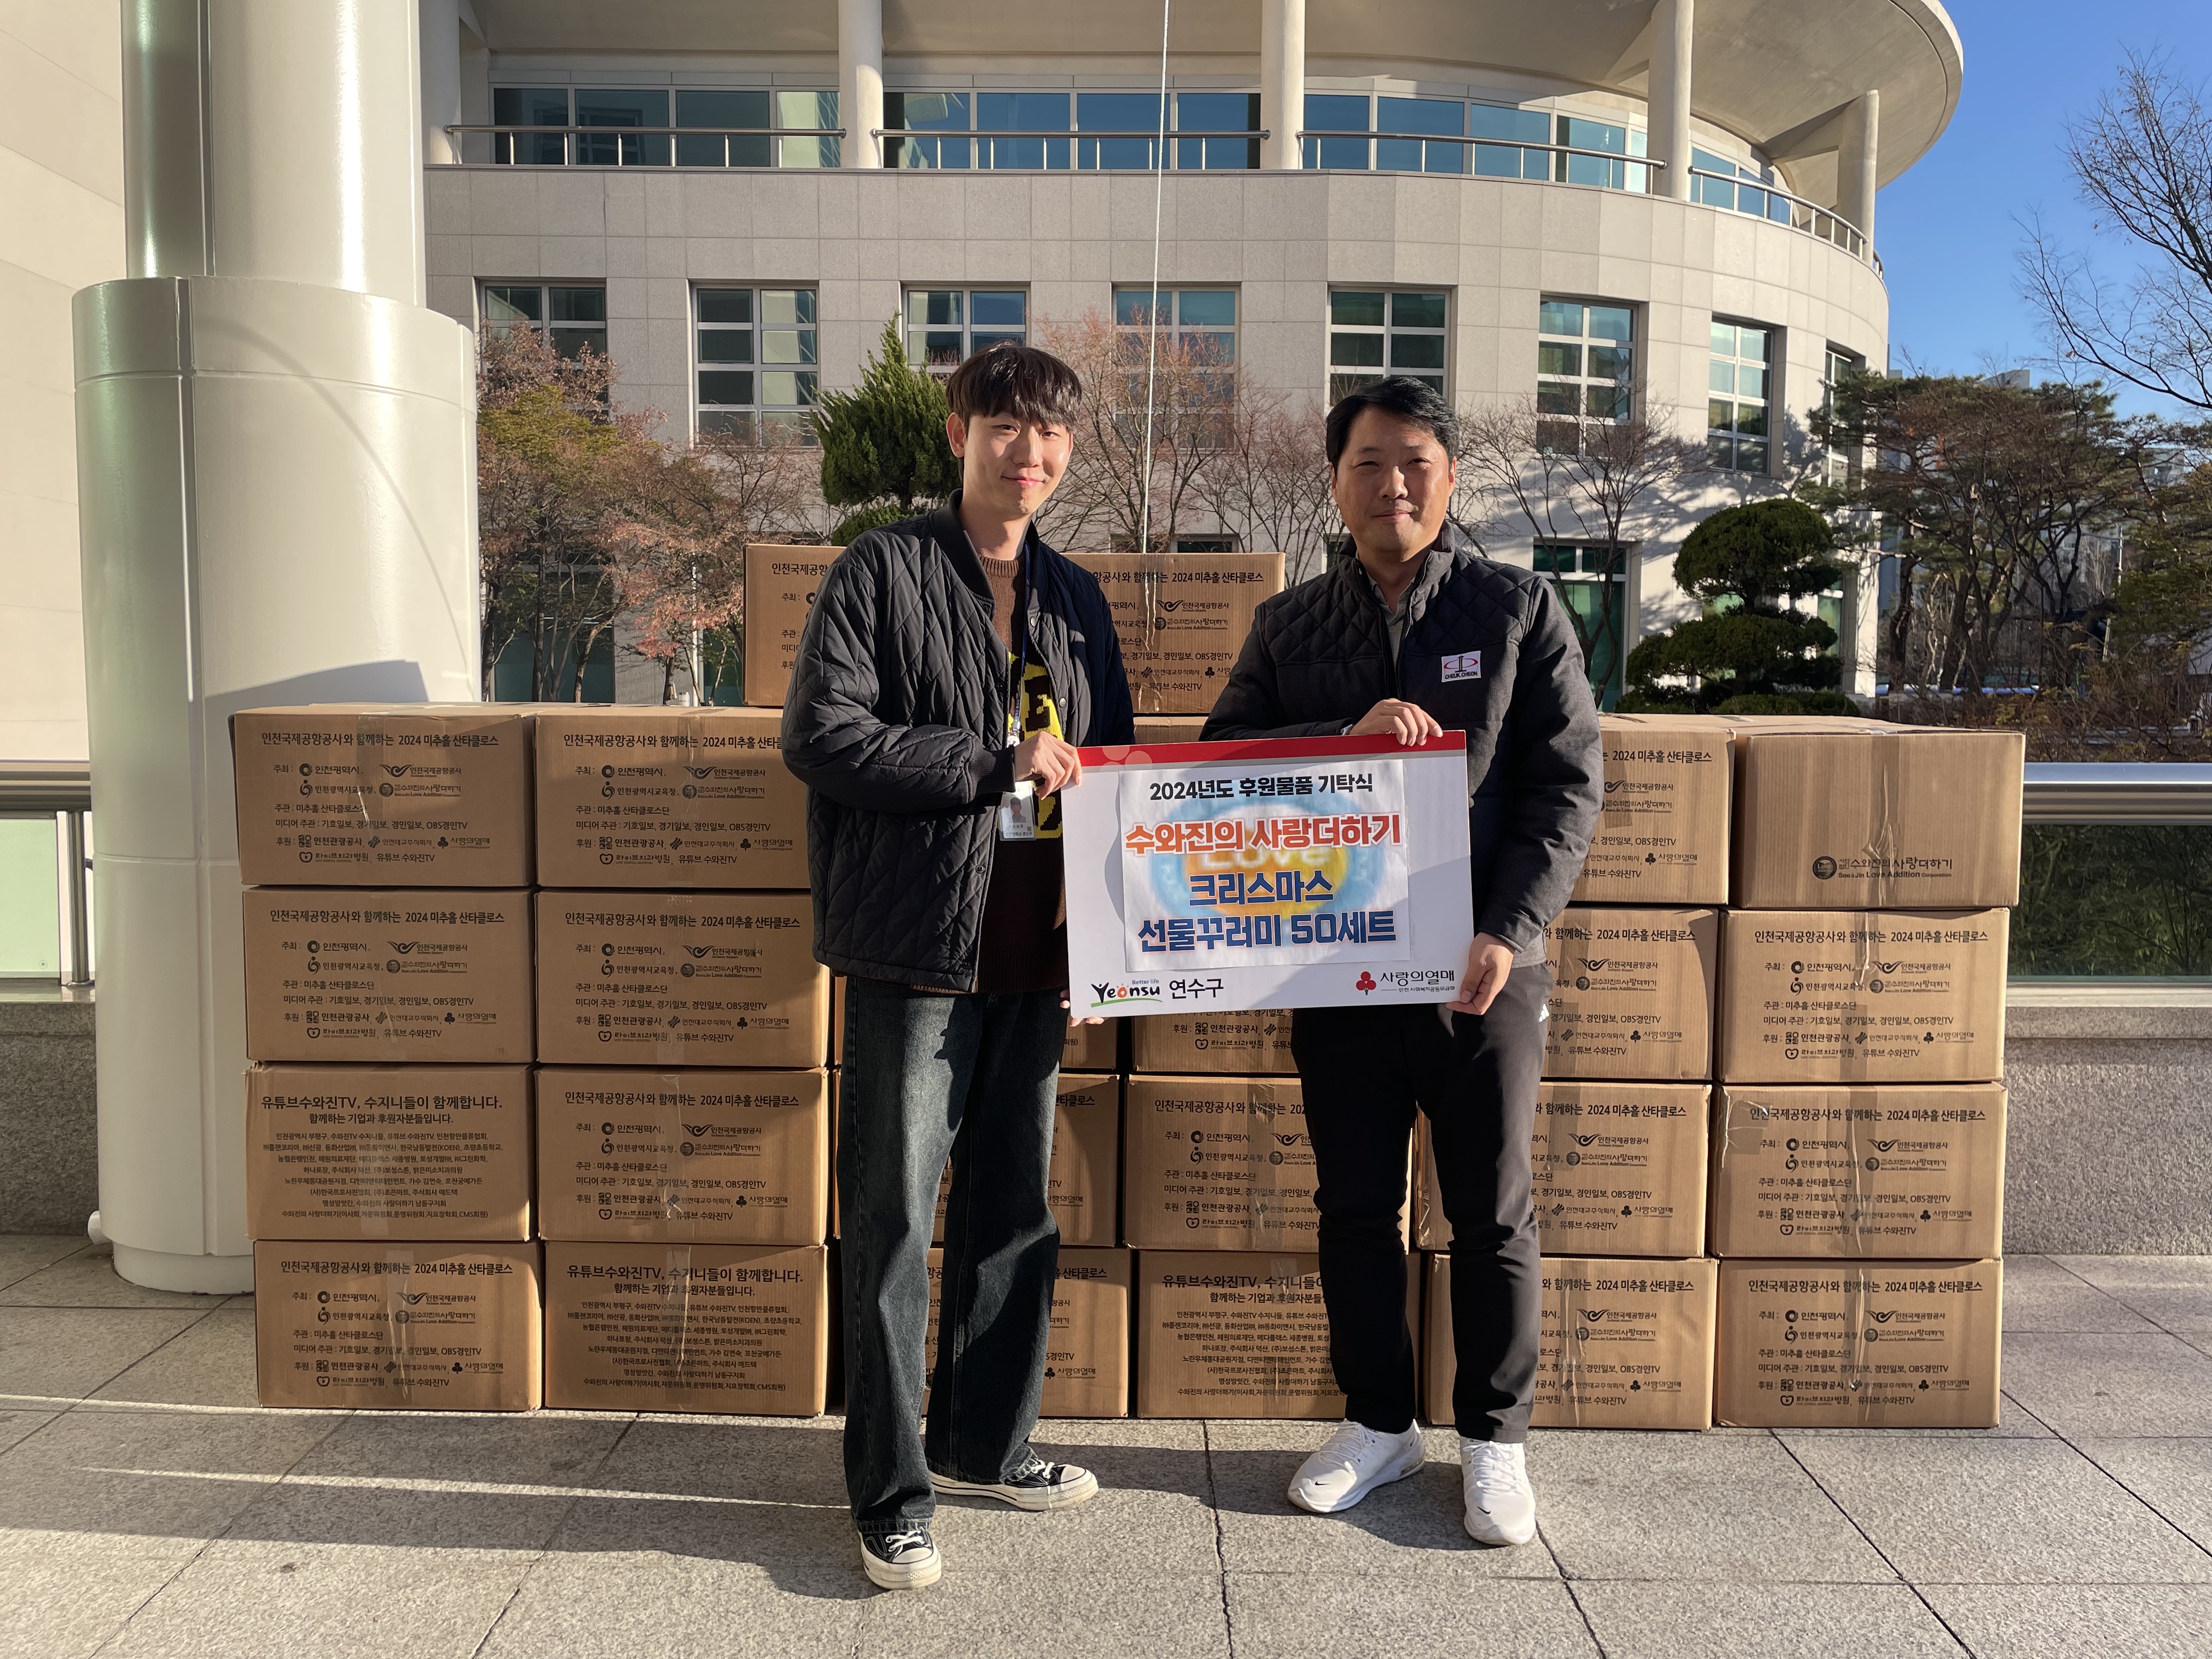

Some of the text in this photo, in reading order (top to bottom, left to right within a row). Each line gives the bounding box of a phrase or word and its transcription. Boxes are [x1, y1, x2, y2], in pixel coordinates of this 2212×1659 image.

[1172, 571, 1263, 583] 2024 미추홀 산타클로스
[262, 732, 499, 747] 인천국제공항공사와 함께하는 2024 미추홀 산타클로스
[565, 734, 756, 749] 인천국제공항공사와 함께하는 2024 미추홀
[1613, 751, 1712, 763] 2024 미추홀 산타클로스
[1150, 773, 1373, 800] 2024년도 후원물품 기탁식
[597, 806, 621, 815] 미추홀
[623, 806, 670, 816] 산타클로스단
[577, 821, 599, 830] 미디어
[623, 821, 656, 831] 기호일보,
[658, 822, 691, 831] 경기일보,
[694, 822, 727, 832] 경인일보,
[729, 822, 771, 832] OBS경인TV
[1125, 814, 1401, 854] 수와진의 사랑더하기
[1600, 836, 1677, 846] 경인일보, OBS경인TV
[679, 855, 702, 864] 유튜브
[703, 855, 737, 864] 수와진TV
[1583, 869, 1641, 878] 유튜브 수와진TV
[1189, 870, 1334, 906] 크리스마스
[270, 910, 505, 924] 인천국제공항공사와 함께하는 2024 미추홀 산타클로스
[566, 913, 800, 929] 인천국제공항공사와 함께하는 2024 미추홀 산타클로스
[1138, 910, 1396, 952] 선물꾸러미 50세트
[1597, 929, 1620, 940] 2024
[1622, 929, 1649, 941] 미추홀
[1651, 929, 1696, 942] 산타클로스
[1756, 930, 1847, 944] 인천국제공항공사와
[1891, 932, 1914, 942] 2024
[1915, 931, 1943, 943] 미추홀
[1944, 930, 1989, 943] 산타클로스
[1380, 970, 1454, 986] 사랑의열매
[1091, 978, 1223, 1003] Yeonsu 연수구
[262, 1096, 502, 1109] 유튜브수와진TV, 수지니들이 함께합니다.
[566, 1092, 799, 1108] 인천국제공항공사와 함께하는 2024 미추홀 산타클로스
[1155, 1100, 1246, 1114] 인천국제공항공사와
[1546, 1103, 1687, 1118] 함께하는 2024 미추홀 산타클로스
[1845, 1109, 1883, 1121] 함께하는
[1887, 1110, 1910, 1120] 2024
[1912, 1110, 1939, 1122] 미추홀
[1941, 1109, 1987, 1122] 산타클로스
[309, 1114, 454, 1124] 함께하는 기업과 후원자분들입니다.
[281, 1261, 513, 1276] 인천국제공항공사와 함께하는 2024 미추홀 산타클로스
[567, 1265, 665, 1279] 유튜브수와진TV,
[736, 1269, 803, 1283] 함께합니다.
[1063, 1267, 1107, 1280] 산타클로스
[614, 1283, 650, 1294] 함께하는
[652, 1284, 679, 1294] 기업과
[1163, 1275, 1261, 1289] 유튜브수와진TV,
[1555, 1278, 1695, 1293] 함께하는 2024 미추홀 산타클로스
[1750, 1279, 1983, 1293] 인천국제공항공사와 2024 미추홀 산타클로스
[1210, 1293, 1275, 1303] 함께하는 기업과
